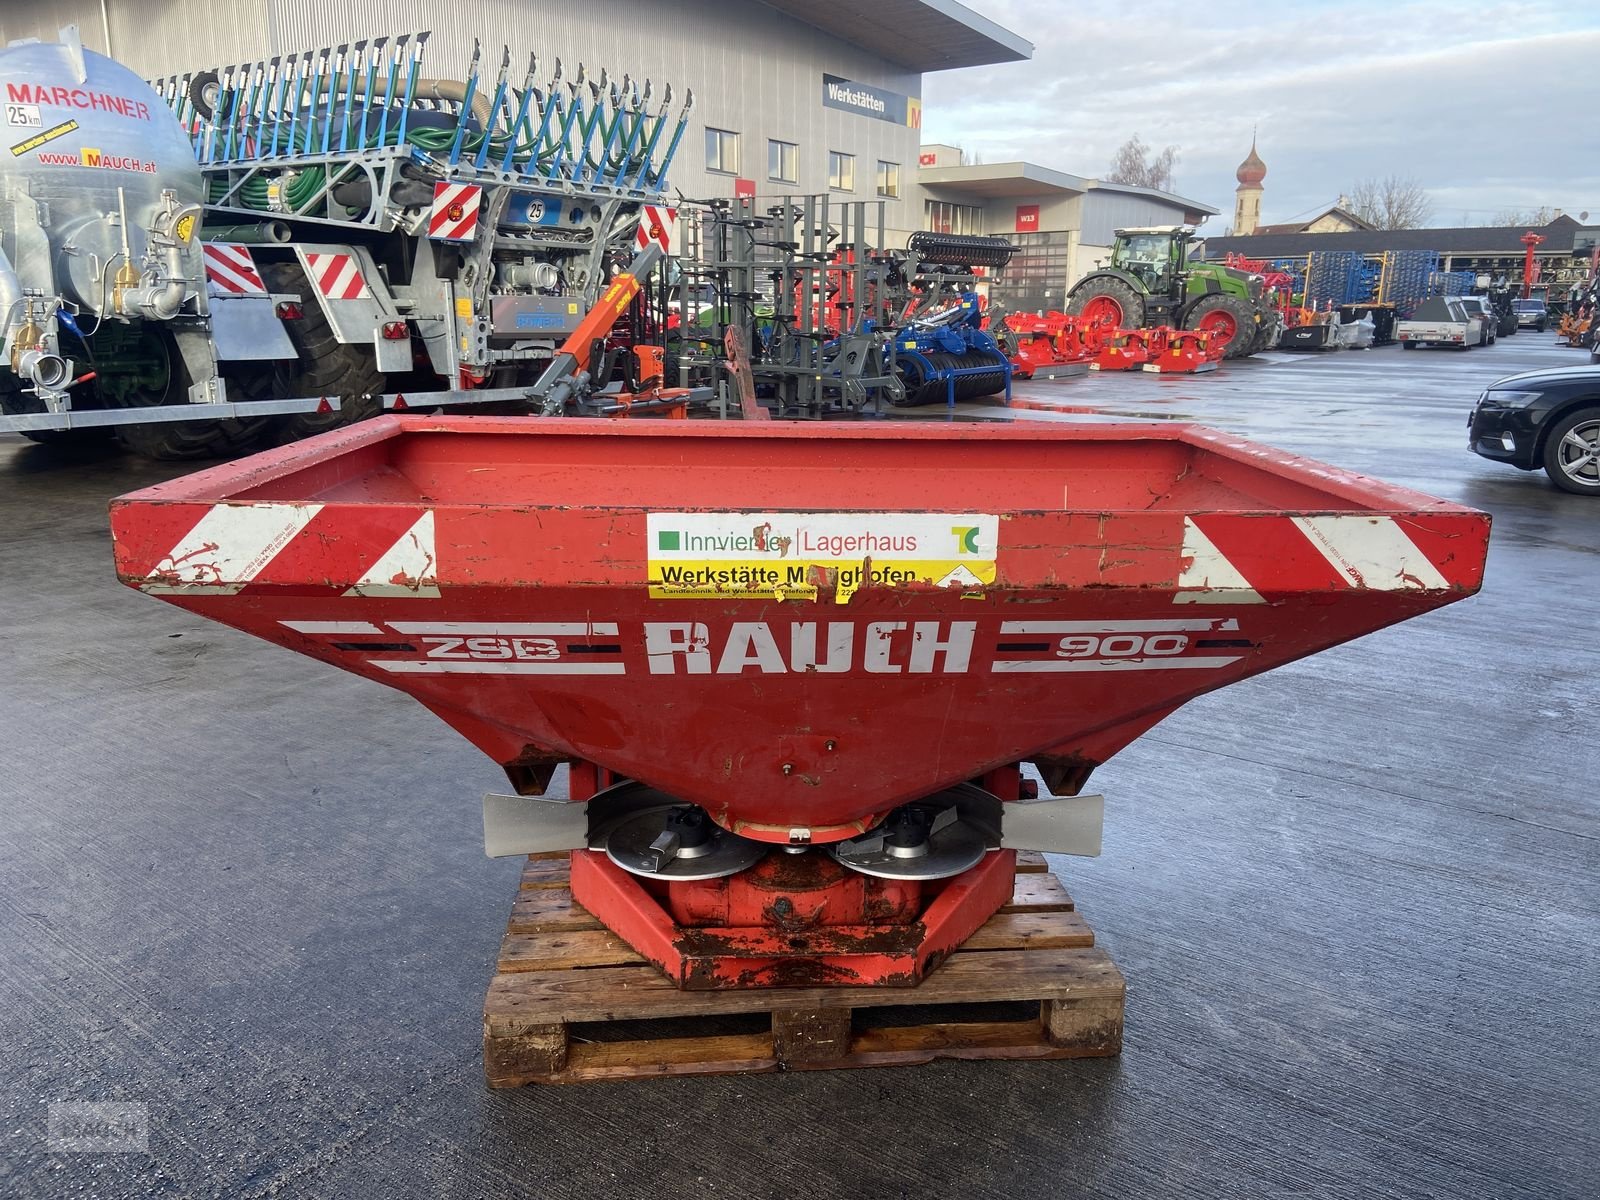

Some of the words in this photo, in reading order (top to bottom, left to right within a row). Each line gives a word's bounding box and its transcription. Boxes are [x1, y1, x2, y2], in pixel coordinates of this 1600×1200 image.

[7, 83, 151, 121] MARCHNER
[828, 83, 885, 112] Werkstätten
[8, 106, 27, 125] 25
[529, 203, 542, 218] 25
[804, 531, 917, 556] Lagerhaus
[661, 566, 779, 583] Werkstätte
[422, 637, 561, 660] ZSB
[643, 621, 977, 675] RAUCH
[1056, 634, 1188, 657] 900
